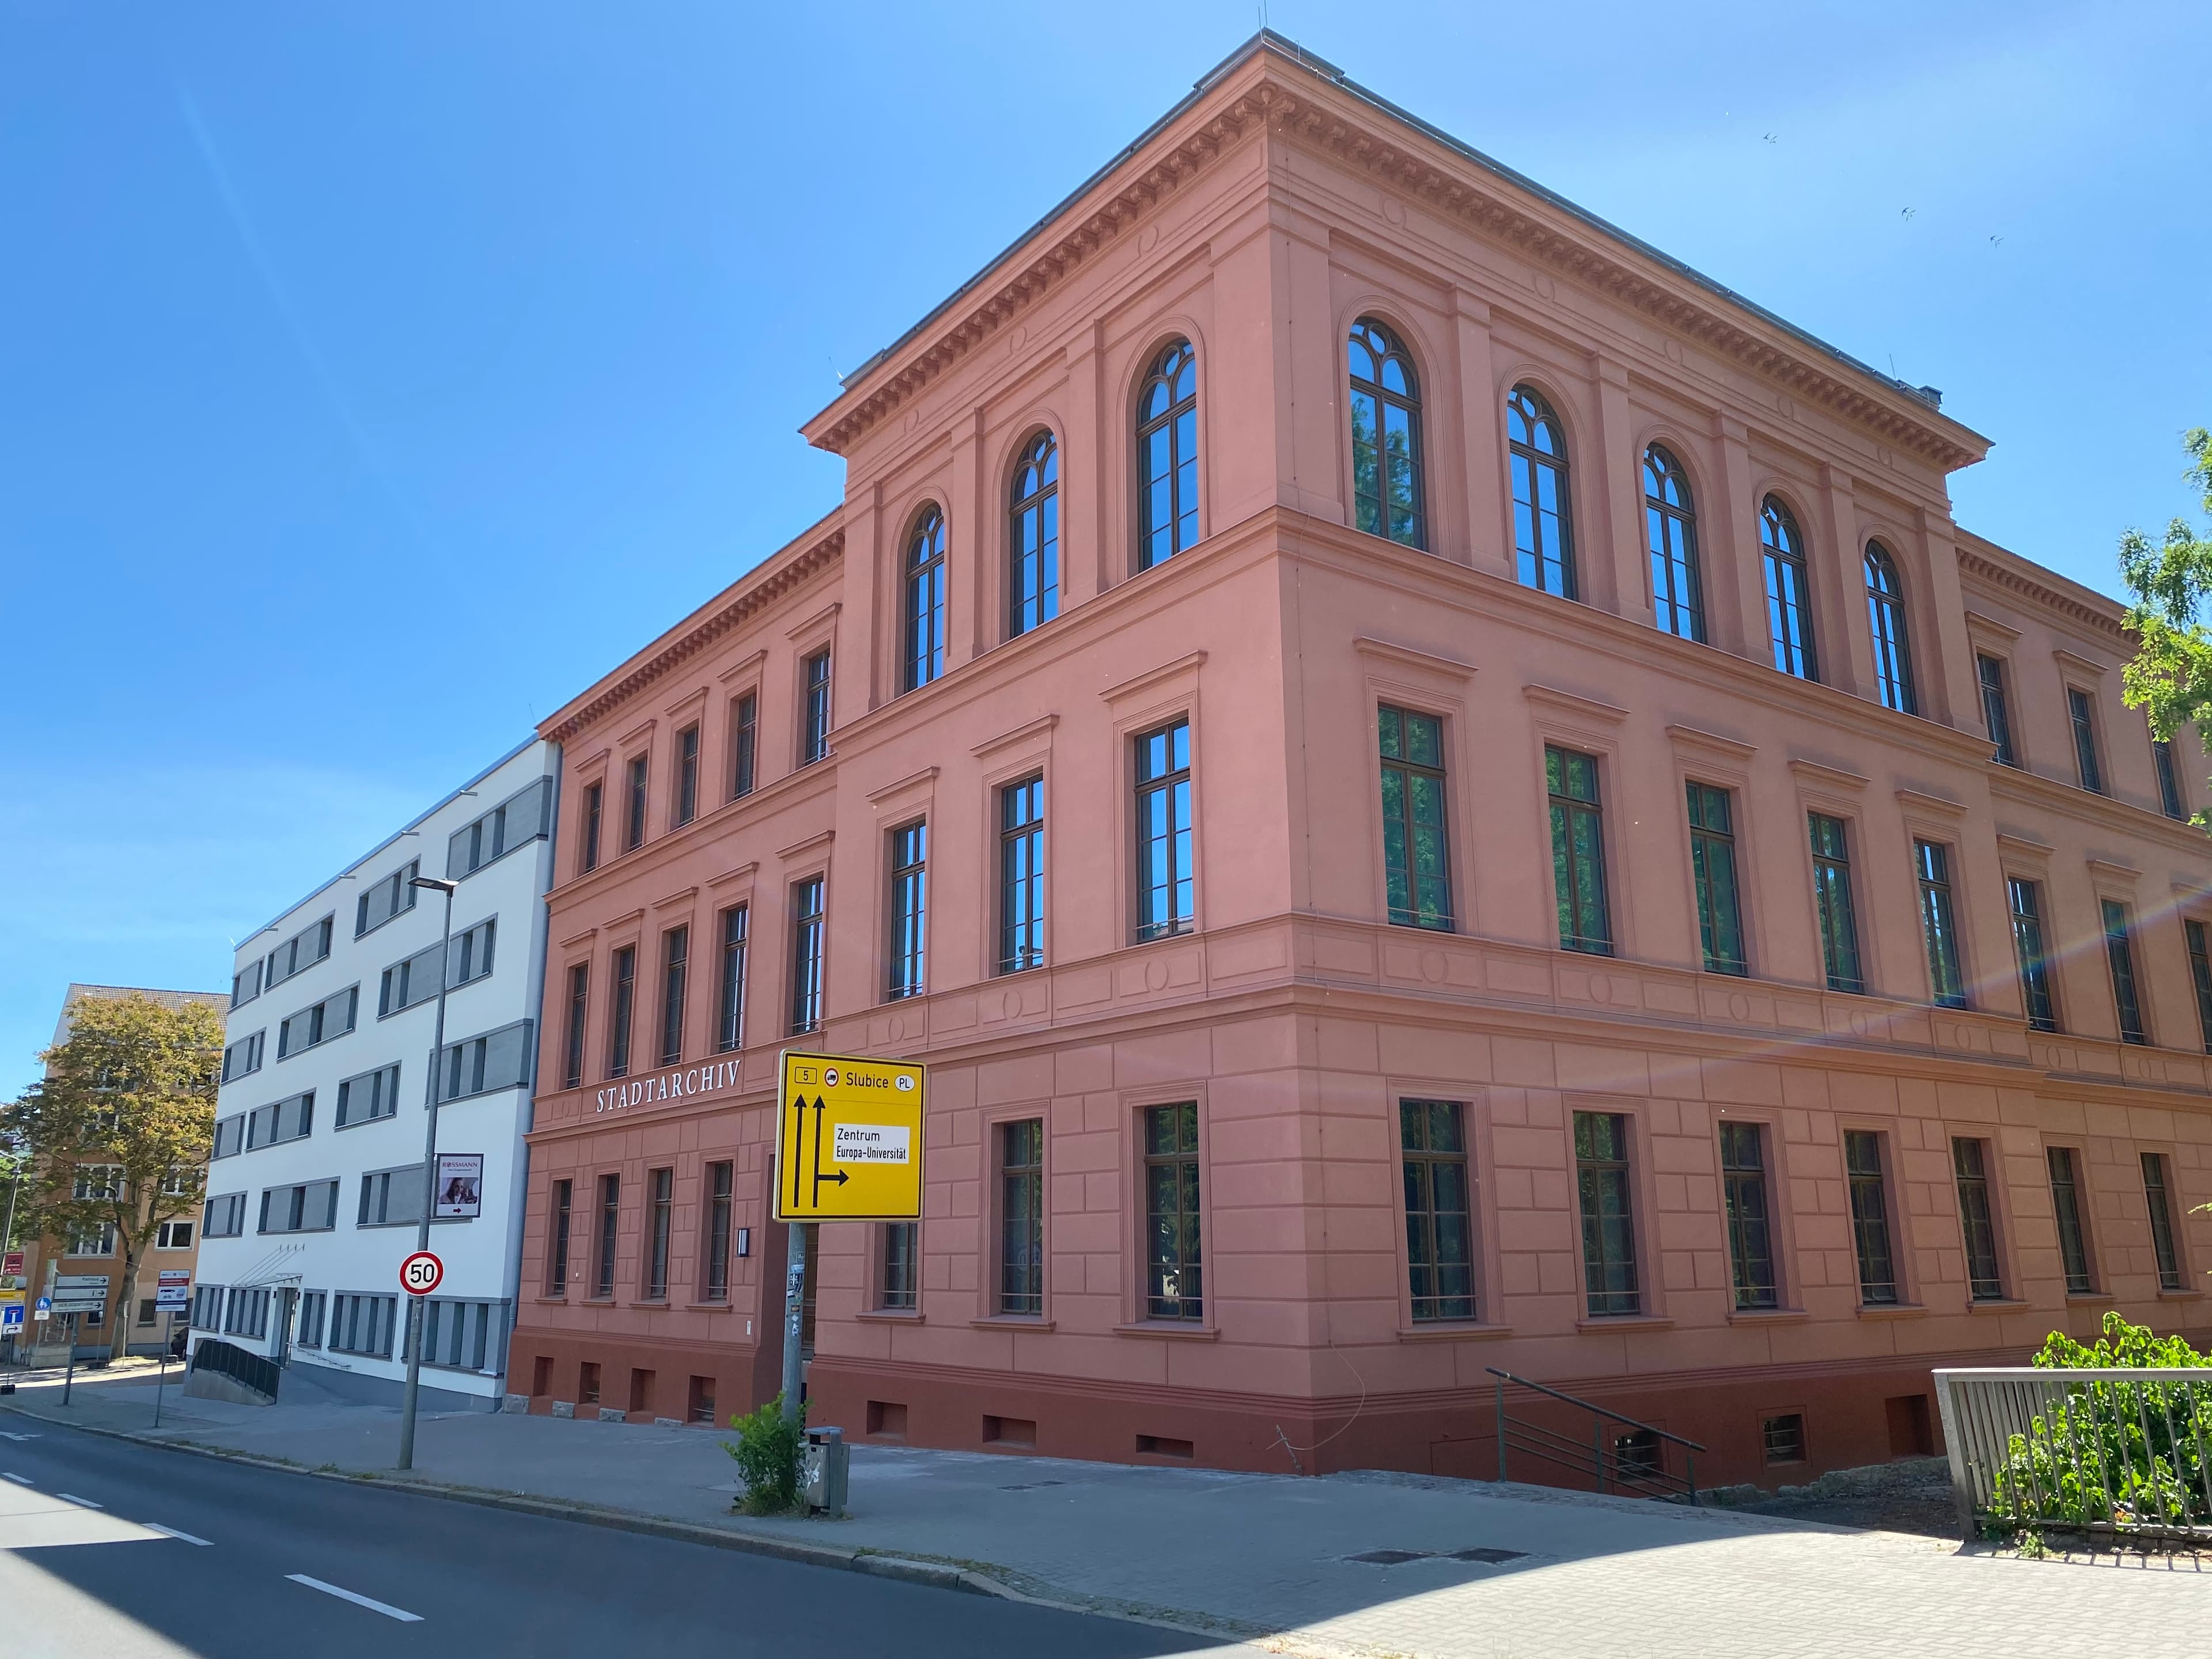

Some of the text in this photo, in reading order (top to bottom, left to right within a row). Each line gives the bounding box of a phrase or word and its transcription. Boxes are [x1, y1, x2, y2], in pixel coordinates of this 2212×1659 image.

[596, 1059, 741, 1113] STADTARCHIV
[802, 1070, 910, 1089] 5 Slubice PL
[837, 1128, 880, 1142] Zentrum
[836, 1146, 906, 1160] Europa-Universität
[410, 1263, 435, 1283] 50
